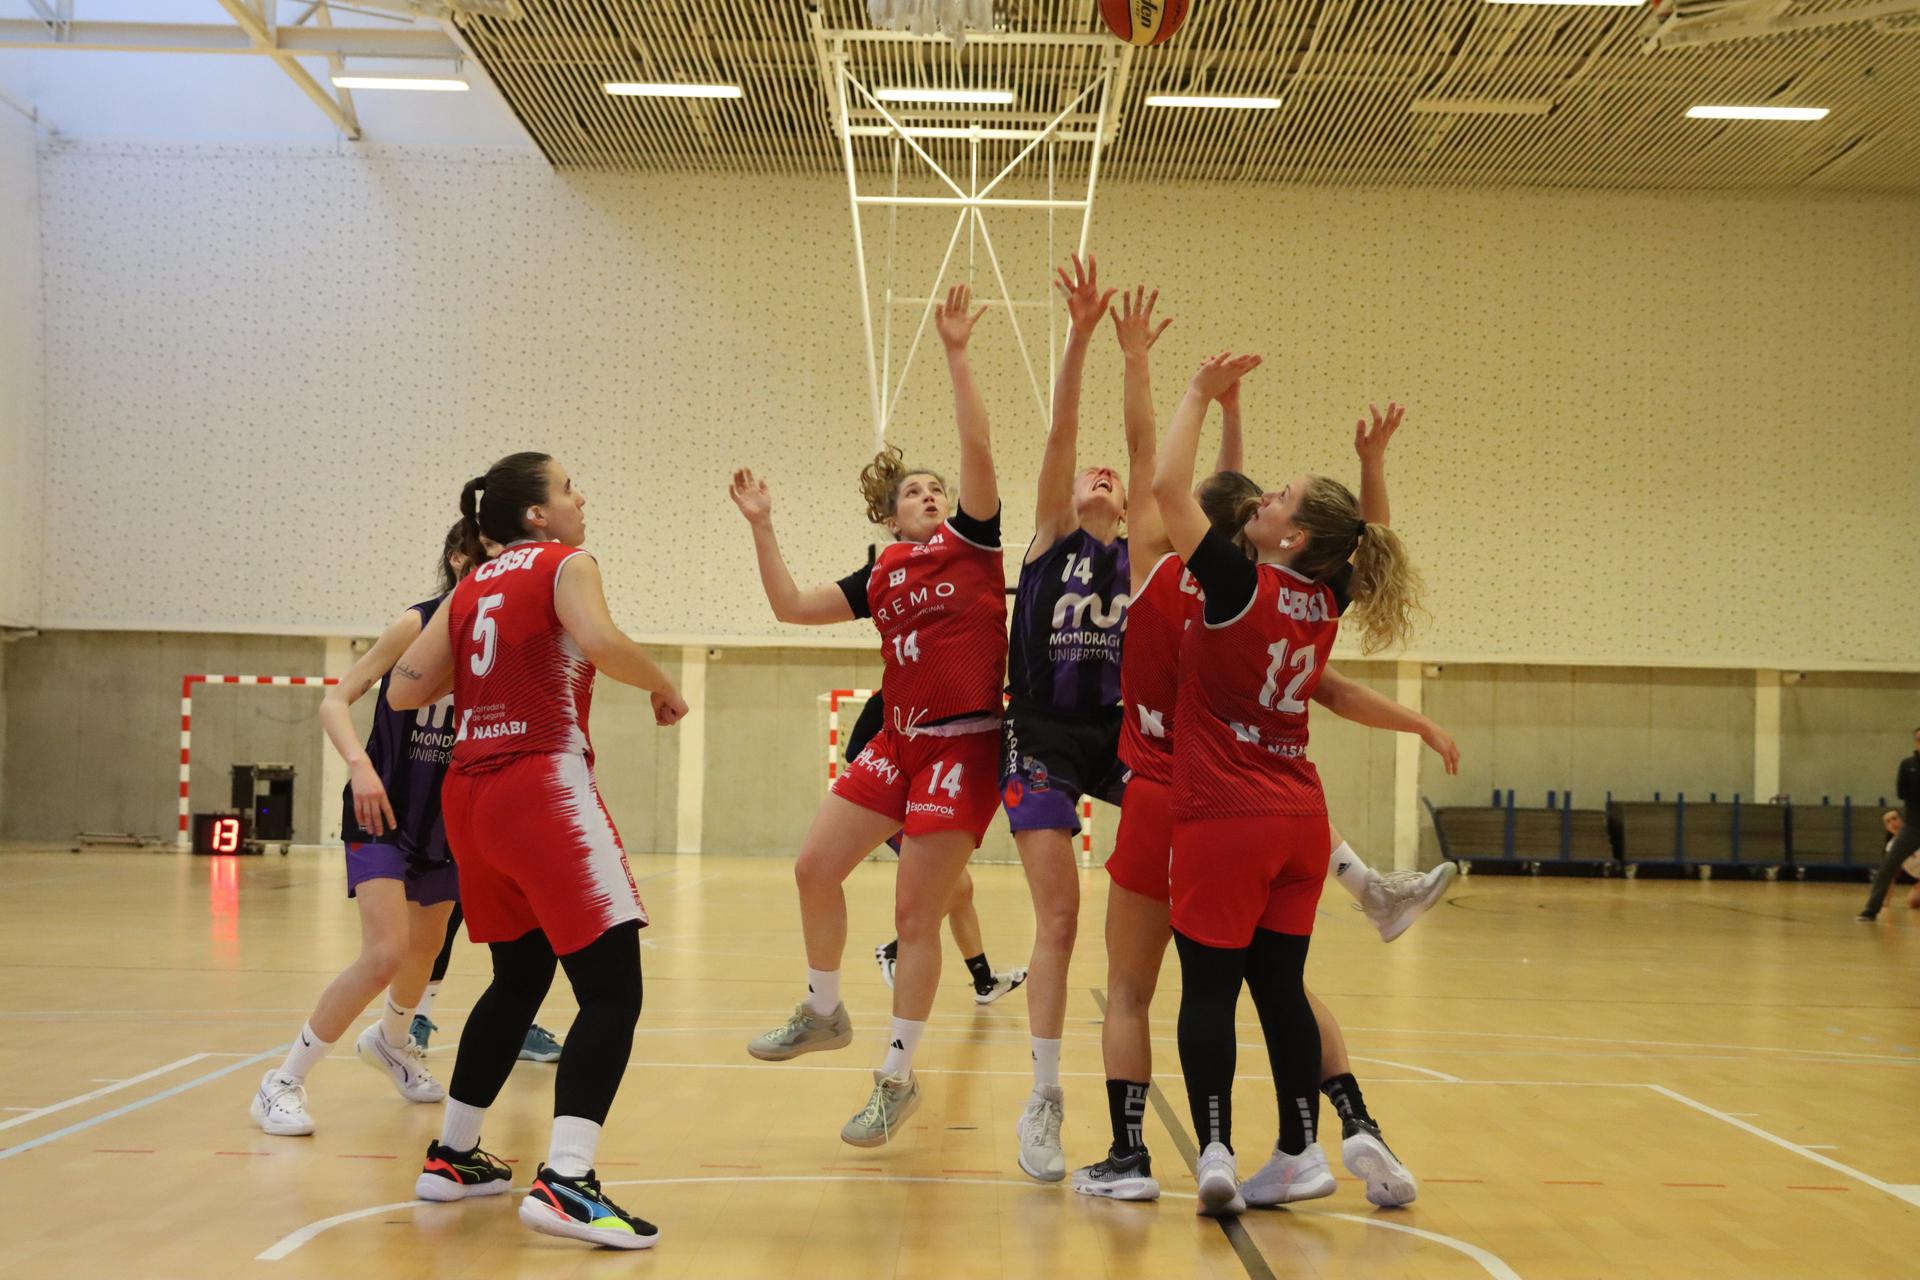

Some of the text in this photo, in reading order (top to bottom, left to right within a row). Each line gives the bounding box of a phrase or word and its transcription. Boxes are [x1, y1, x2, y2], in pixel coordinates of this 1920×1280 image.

[475, 547, 544, 582] CBSI
[1061, 553, 1093, 585] 14
[470, 592, 505, 679] 5
[892, 629, 920, 666] 14
[1258, 637, 1316, 715] 12
[472, 721, 528, 740] NASABI
[927, 761, 965, 799] 14
[910, 802, 955, 816] Espabrok
[212, 819, 240, 852] 13
